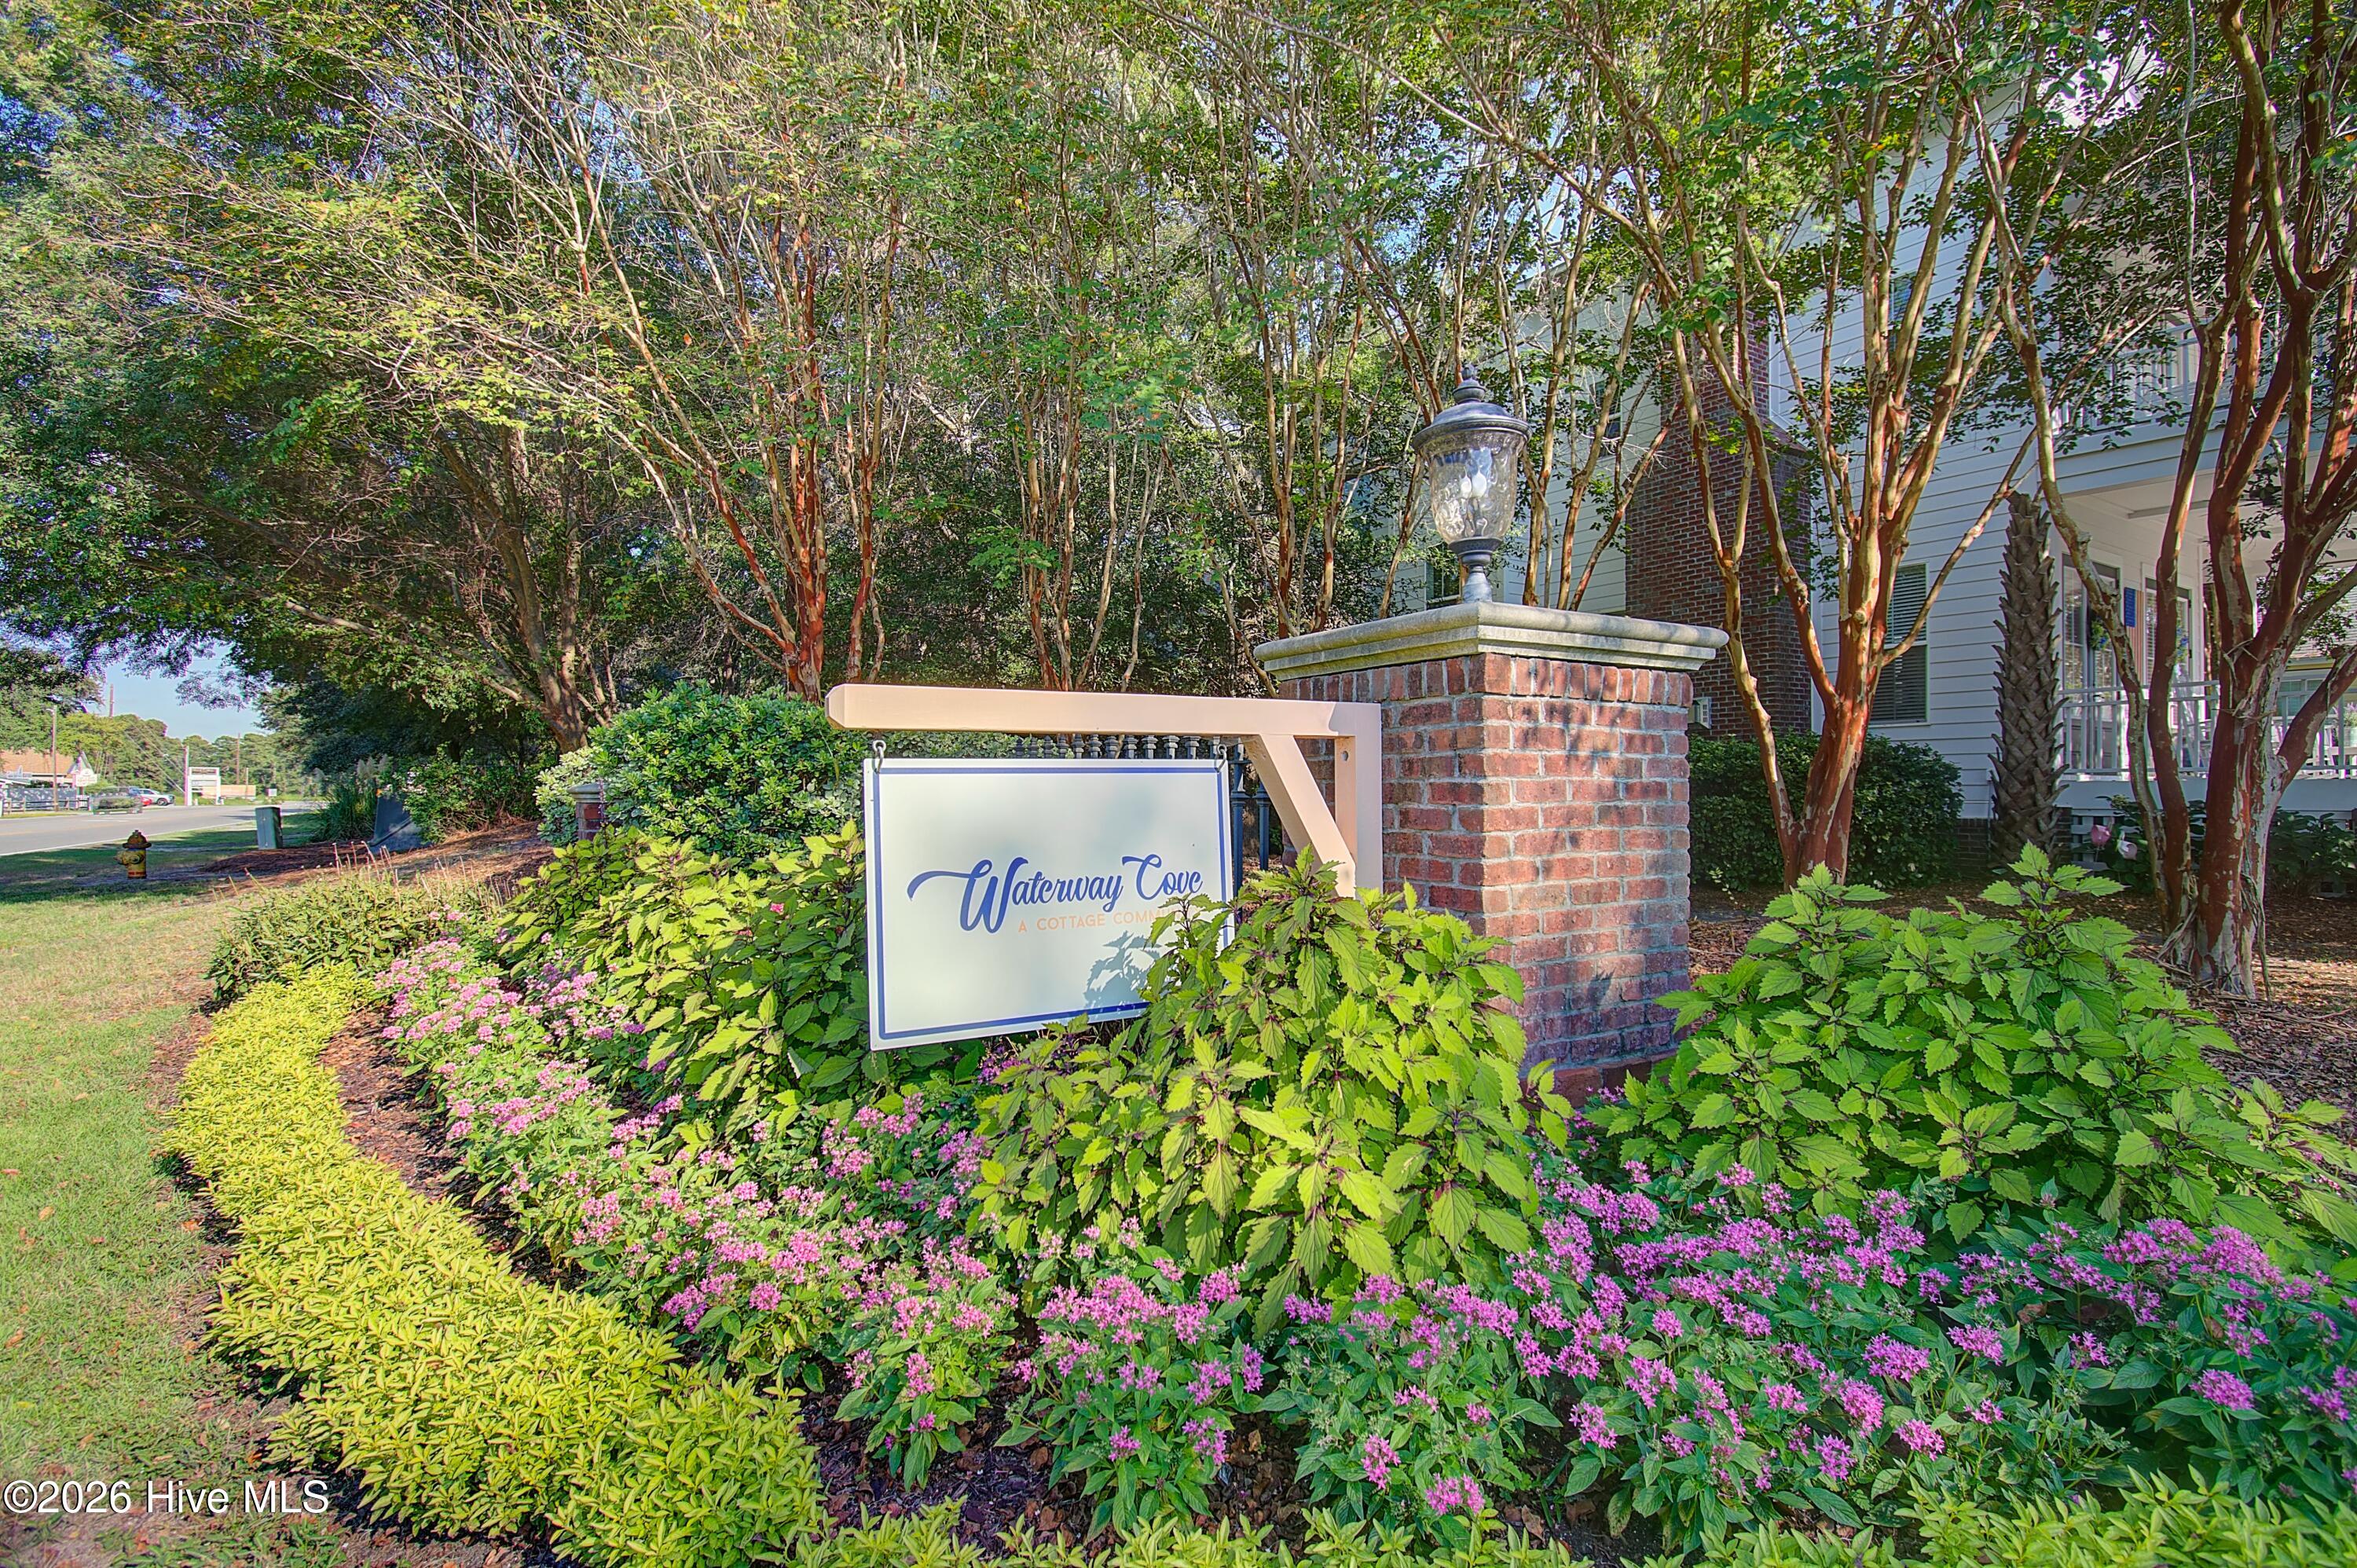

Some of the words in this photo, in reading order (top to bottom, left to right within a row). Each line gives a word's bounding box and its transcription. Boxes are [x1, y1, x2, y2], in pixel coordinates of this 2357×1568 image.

[907, 856, 1123, 933] Waterway
[1122, 854, 1204, 899] Cove
[1018, 919, 1028, 932] A
[1036, 914, 1105, 930] COTTAGE
[1113, 907, 1200, 924] COMMU
